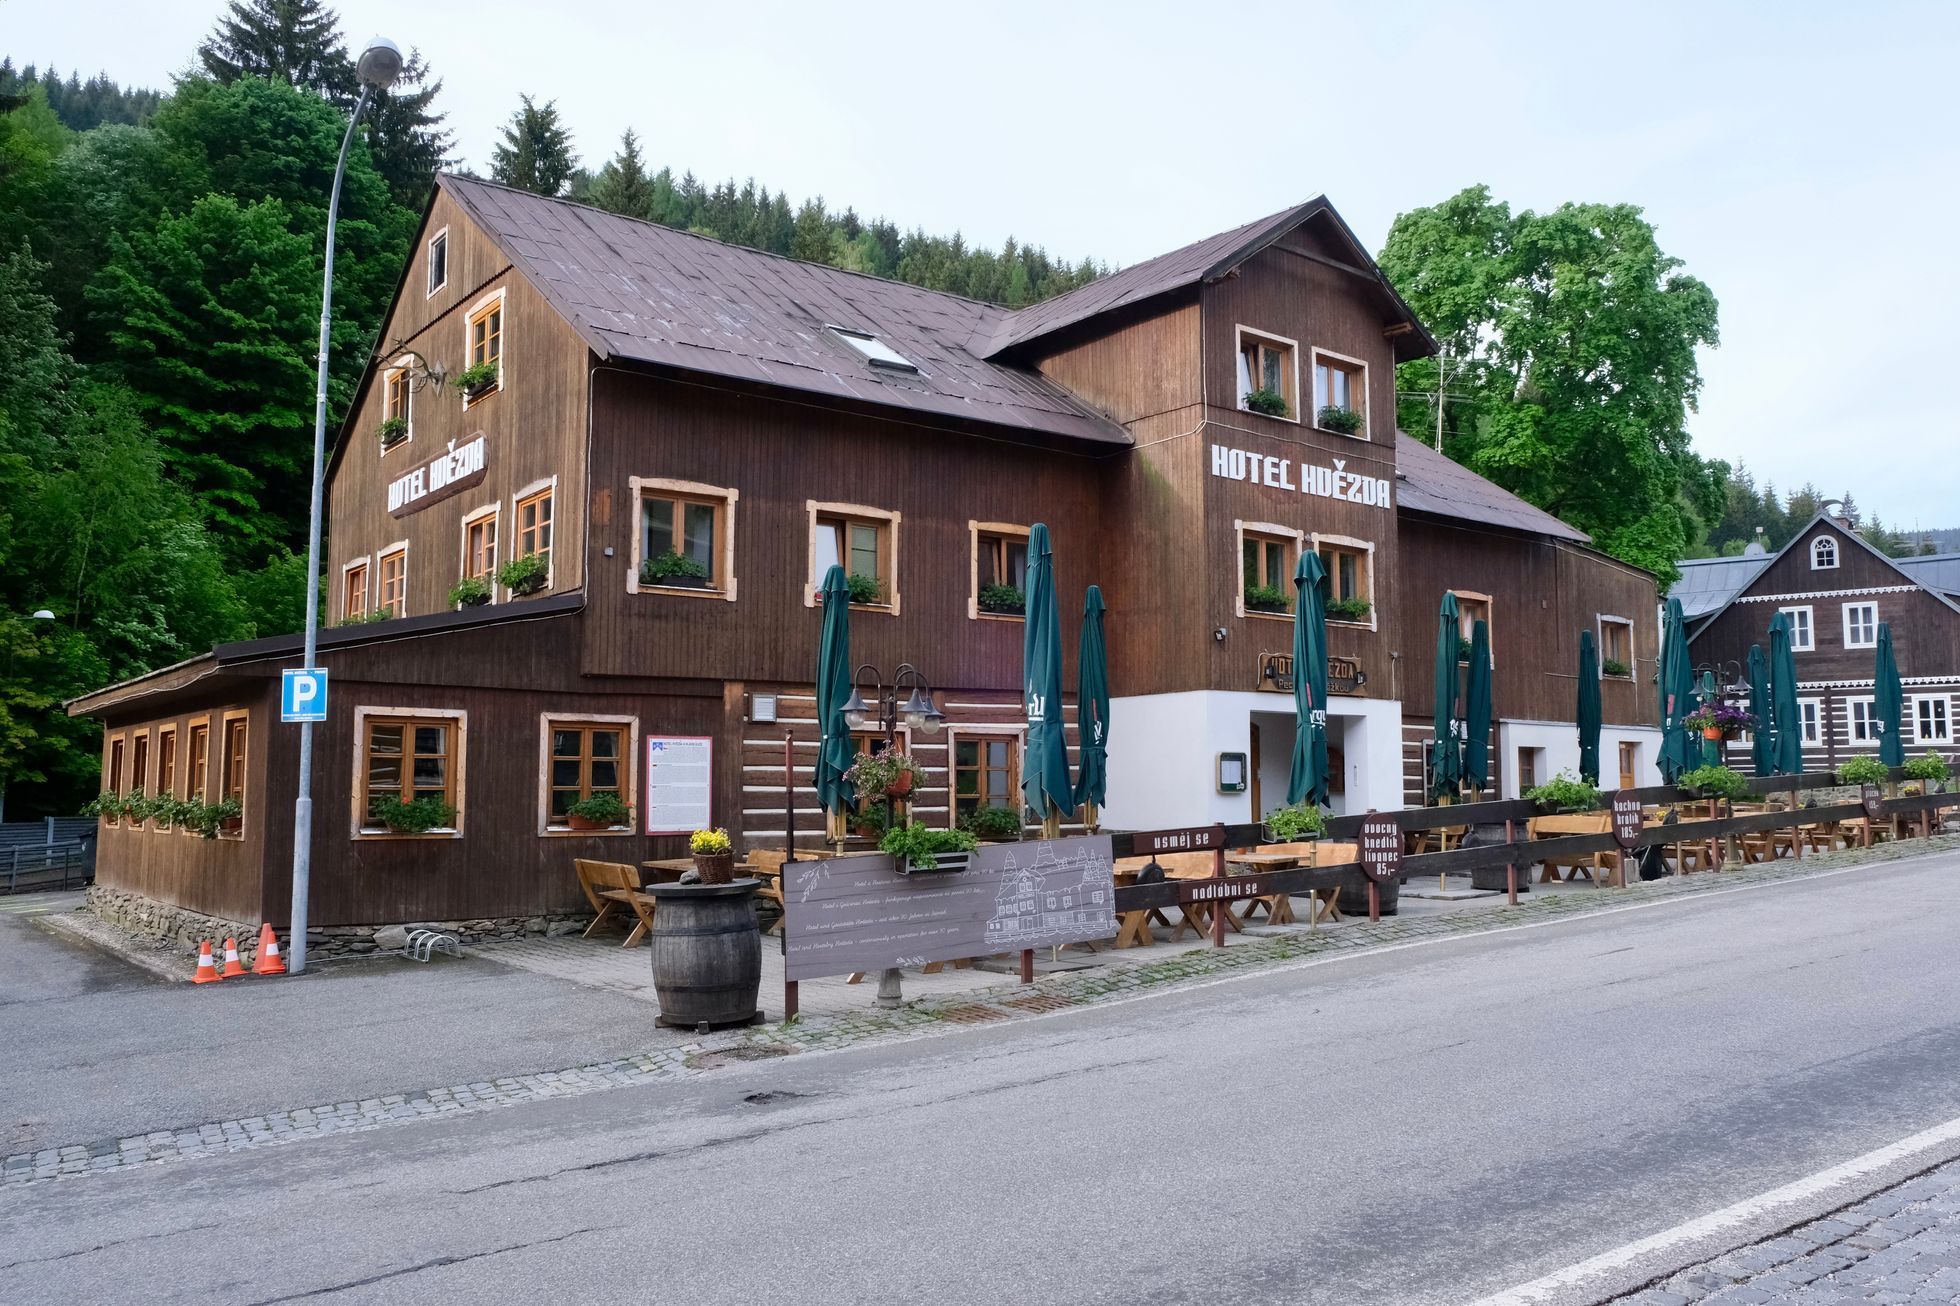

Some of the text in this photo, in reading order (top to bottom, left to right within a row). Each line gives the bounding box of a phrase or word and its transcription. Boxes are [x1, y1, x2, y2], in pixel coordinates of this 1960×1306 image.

[388, 437, 485, 513] HOTEL HVĚZDA
[1211, 444, 1391, 509] HOTEL HVĚZDA
[1271, 657, 1292, 674] HOT
[293, 675, 317, 713] P
[1364, 821, 1397, 836] ovocný
[1154, 832, 1209, 849] usměj se
[1364, 834, 1398, 848] knedlík
[1365, 849, 1398, 862] lívanec
[1192, 881, 1258, 900] nadlábni se
